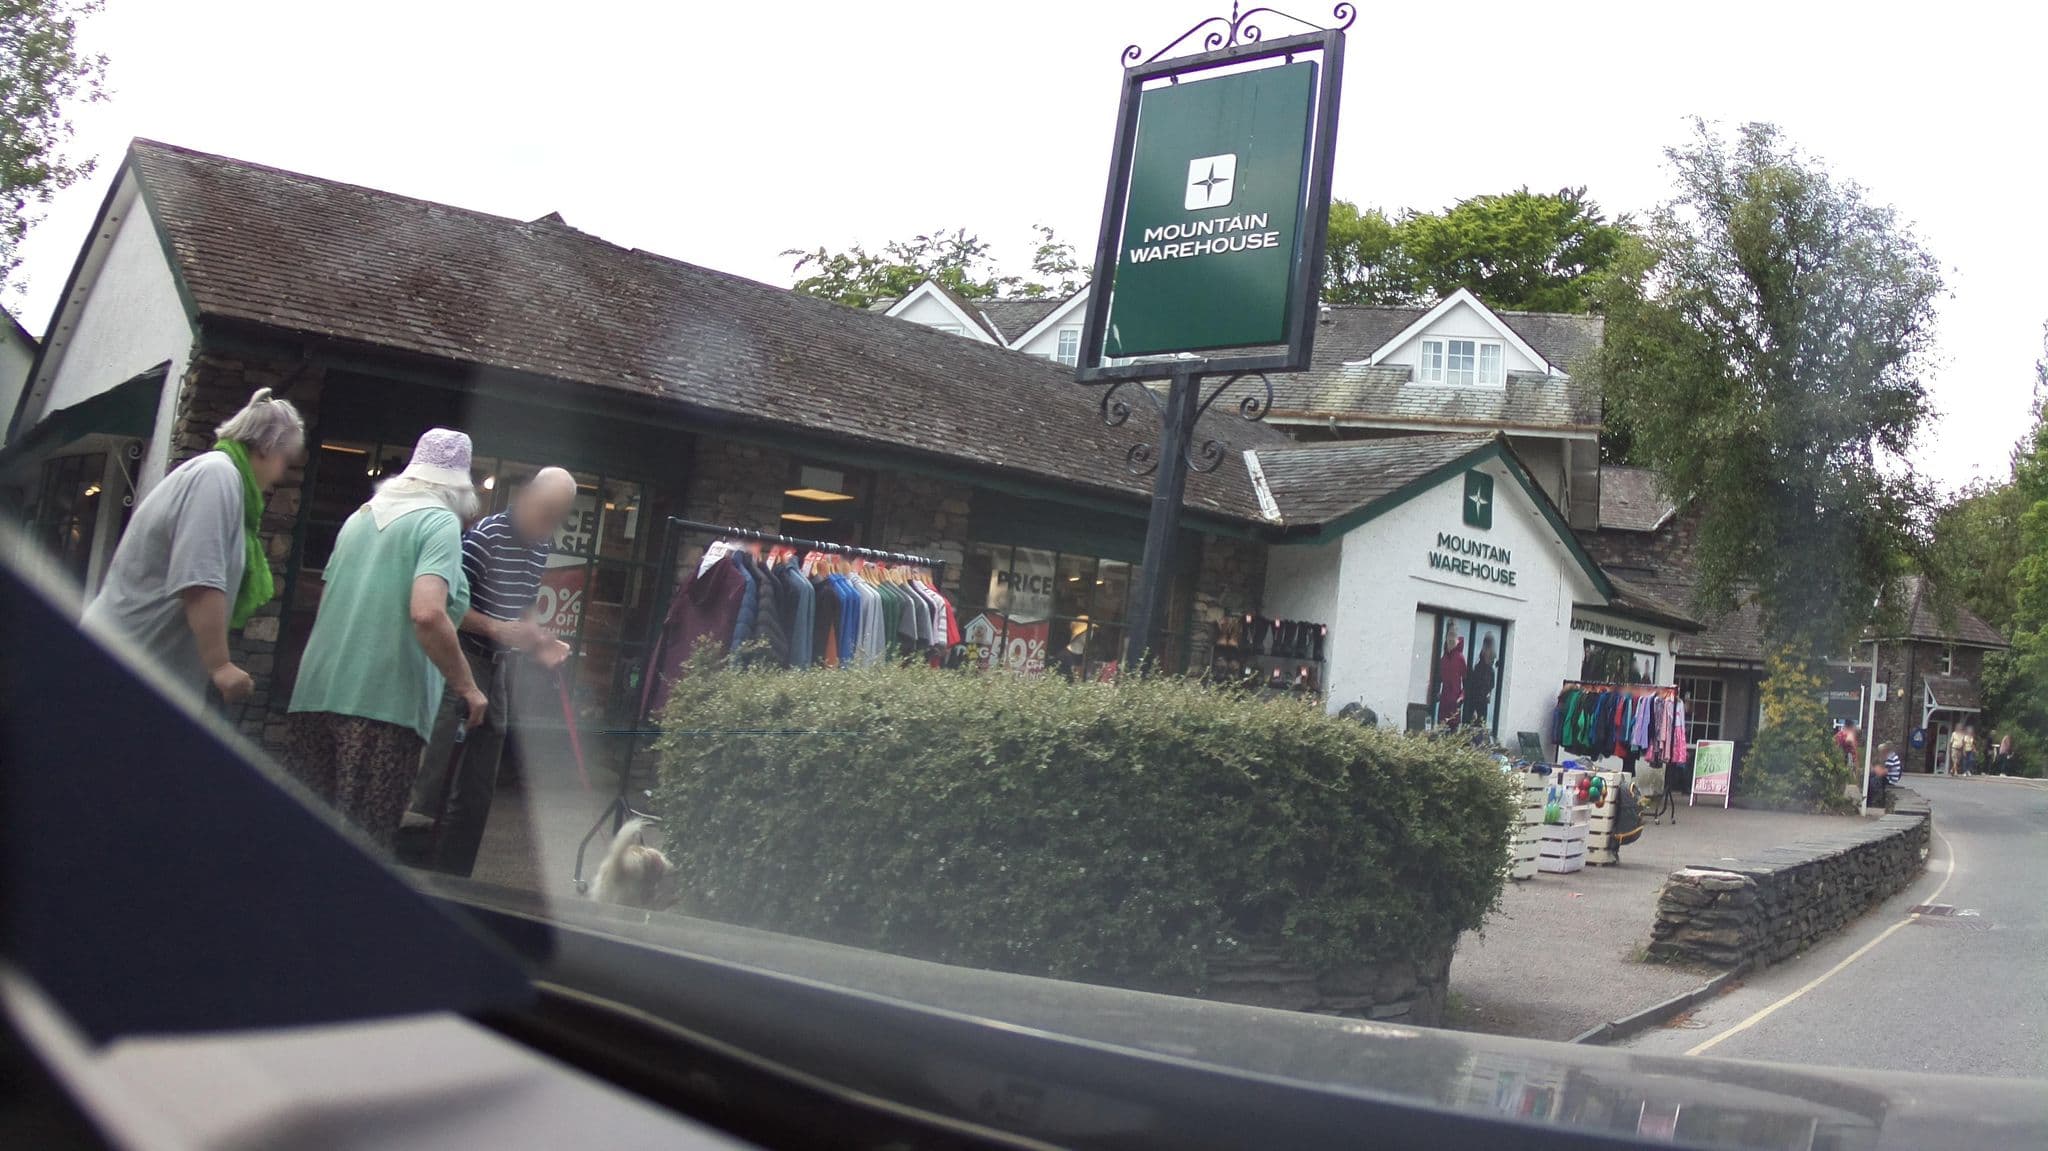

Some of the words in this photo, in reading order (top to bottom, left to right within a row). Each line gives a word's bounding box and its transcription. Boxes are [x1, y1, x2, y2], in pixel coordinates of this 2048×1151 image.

[1144, 212, 1268, 243] MOUNTAIN
[1130, 231, 1280, 263] WAREHOUSE
[1437, 532, 1511, 565] MOUNTAIN
[998, 570, 1052, 595] PRICE
[1429, 551, 1516, 587] WAREHOUSE
[1605, 624, 1655, 646] WAREHOUSE
